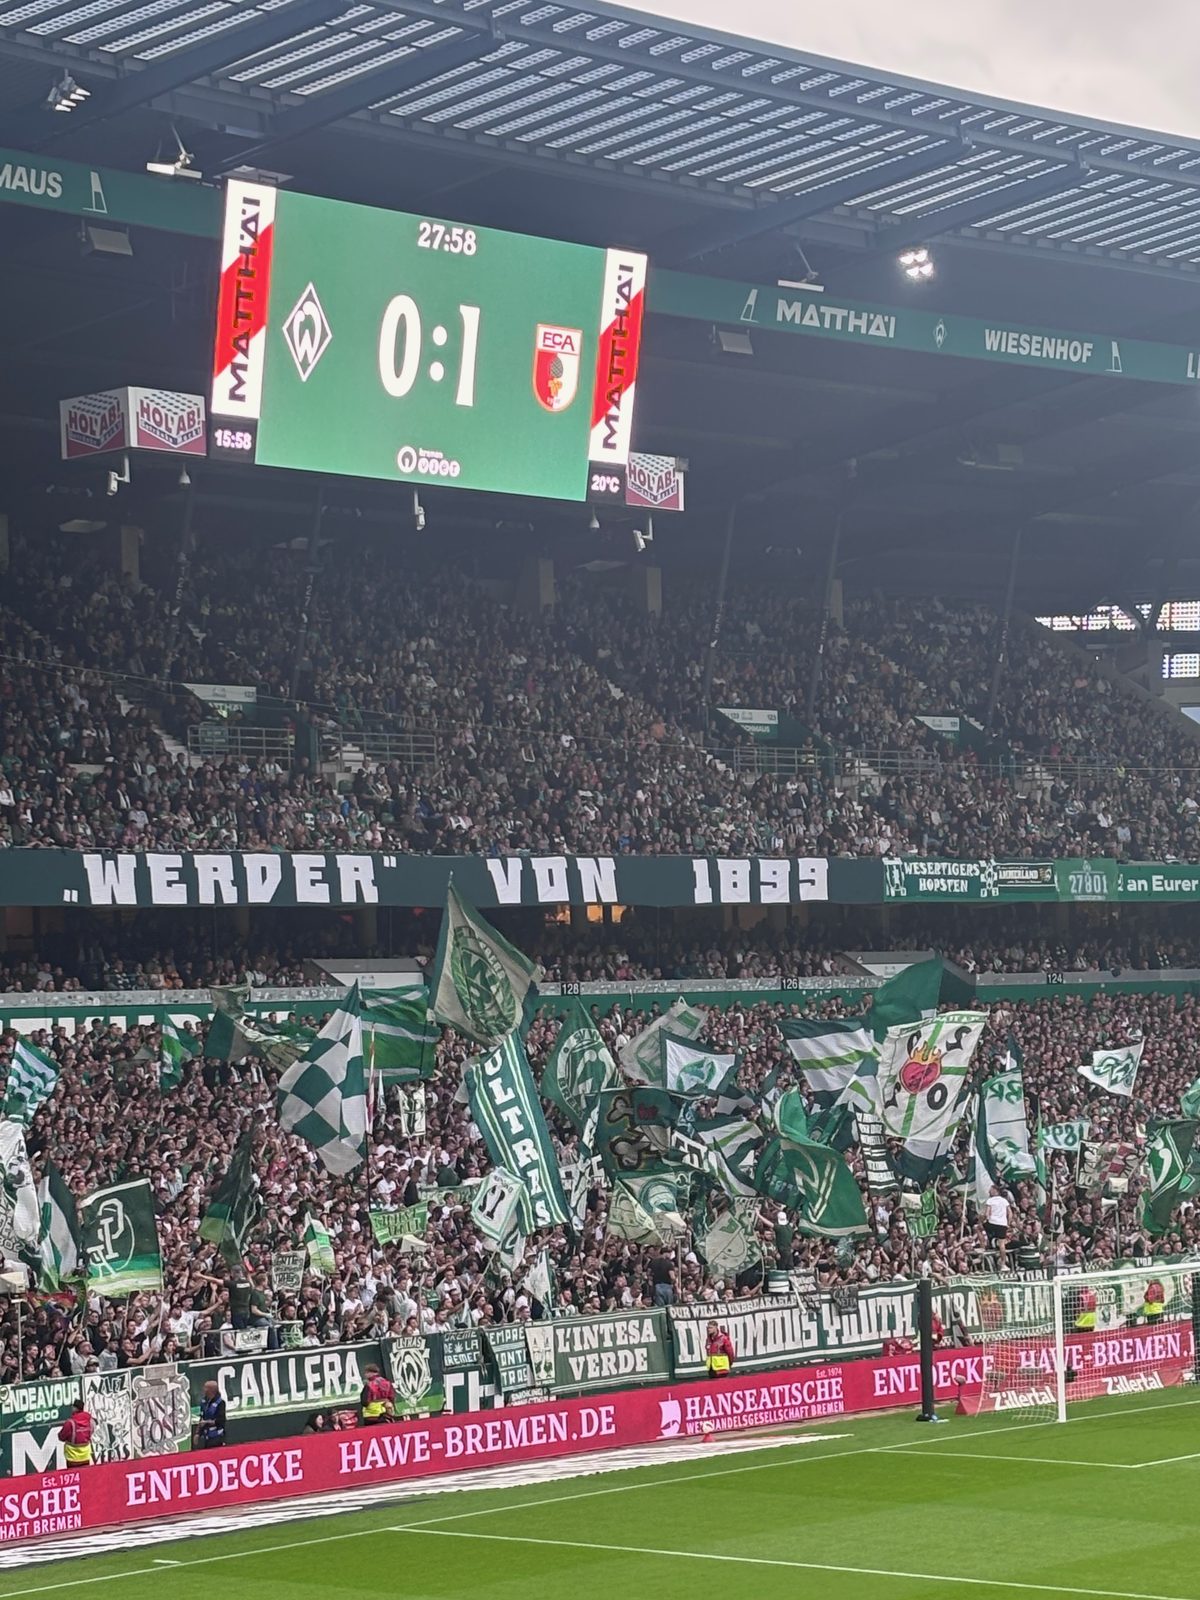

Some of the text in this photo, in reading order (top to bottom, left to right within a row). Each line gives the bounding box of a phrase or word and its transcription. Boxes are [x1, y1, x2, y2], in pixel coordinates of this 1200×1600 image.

[417, 221, 477, 256] 27:58
[228, 196, 261, 402] MATTHÄI
[776, 298, 896, 338] MATTHÄI
[542, 331, 575, 352] FCA
[984, 328, 1094, 363] WIESENHOF
[602, 264, 634, 450] MATTHÄI
[214, 428, 252, 450] 15:58
[590, 474, 620, 493] 20°C
[485, 856, 618, 904] VON
[692, 857, 829, 904] 1899
[904, 861, 980, 877] WESERTIGERS
[919, 878, 968, 893] HOPSTEN
[1127, 879, 1148, 892] an
[1152, 874, 1199, 892] Eurer
[562, 983, 579, 995] 128
[782, 978, 798, 990] 126
[1047, 973, 1063, 984] 124
[670, 1295, 799, 1319] OUR WILL IS UNBREAKABLE
[555, 1318, 657, 1353] L'INTESA
[568, 1347, 648, 1381] VERDE
[217, 1351, 364, 1411] CAILLERA
[1103, 1370, 1164, 1396] Zillertal
[685, 1377, 844, 1421] HANSEATISCHE
[811, 1401, 844, 1416] BREMEN
[989, 1385, 1057, 1411] Zillertal
[25, 1409, 59, 1424] 3000
[339, 1405, 616, 1475] HAWE-BREMEN.DE
[42, 1472, 81, 1489] Est. 1974
[126, 1448, 303, 1507] ENTDECKE
[33, 1513, 82, 1534] BREMEN
